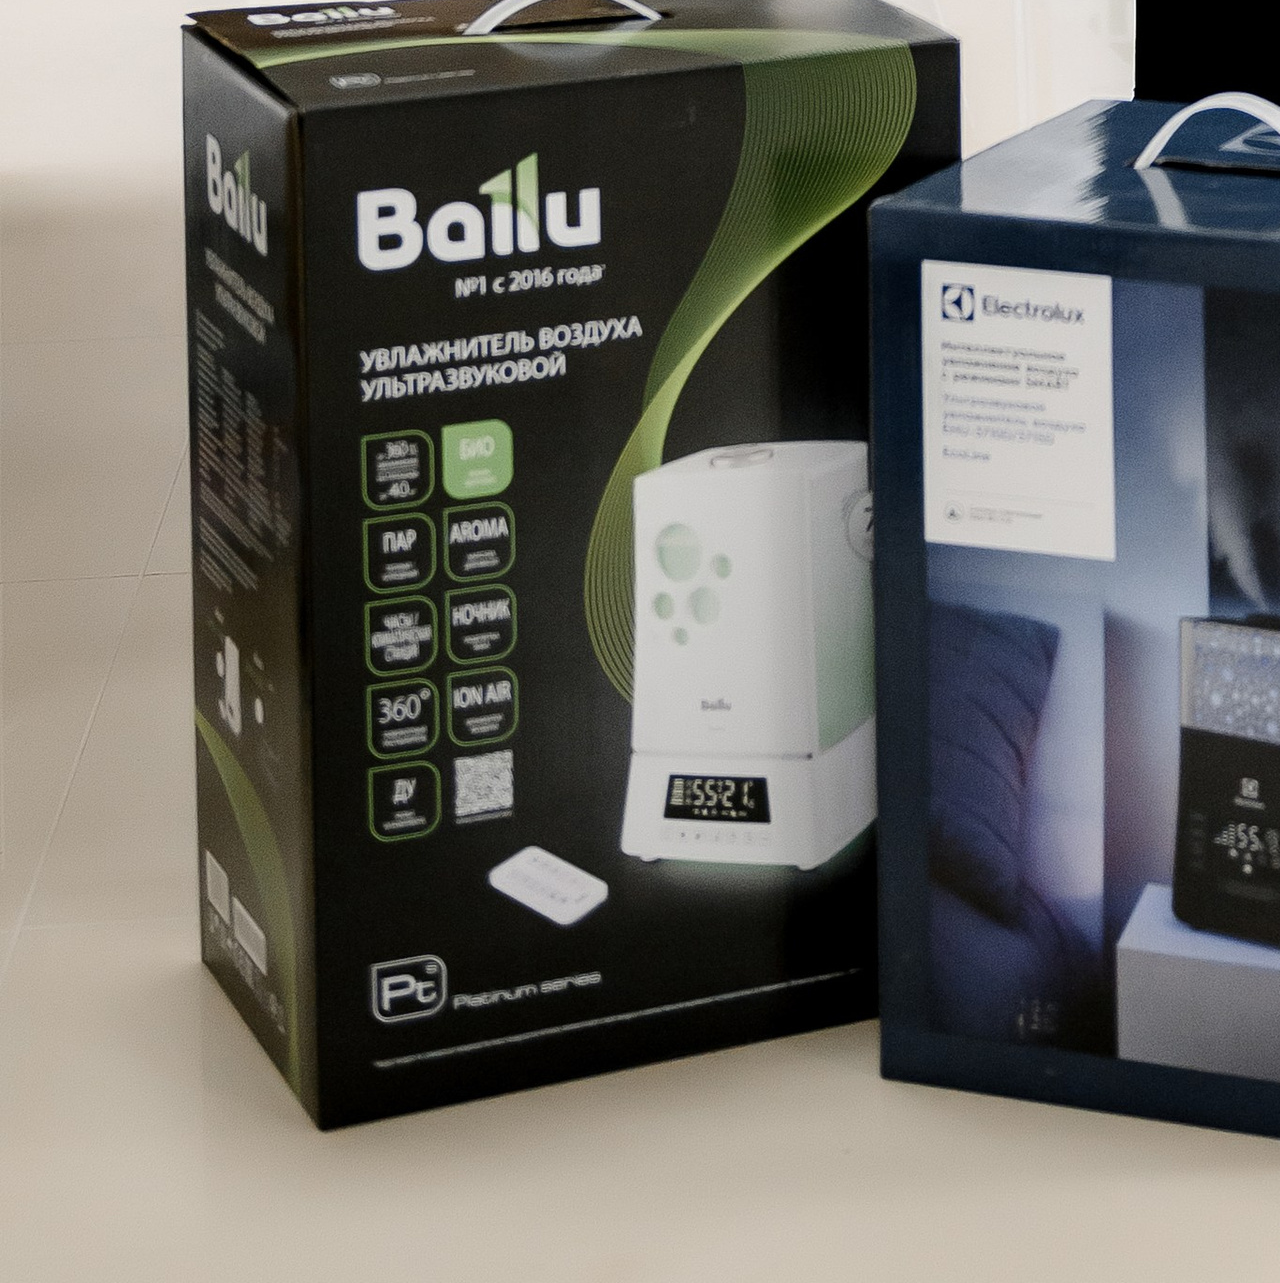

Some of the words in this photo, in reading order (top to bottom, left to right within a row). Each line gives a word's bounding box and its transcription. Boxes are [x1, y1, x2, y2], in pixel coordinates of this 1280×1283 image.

[206, 134, 268, 258] Ballu
[356, 152, 601, 271] Ballu
[455, 275, 487, 298] №1
[492, 276, 505, 294] с
[508, 266, 554, 292] 2016
[981, 294, 1085, 325] Electrolux
[360, 333, 535, 374] УВЛАЖНИТЕЛЬ
[538, 315, 643, 350] ВОЗДУХА
[360, 352, 567, 402] УЛЬТРАЗВУКОВОЙ
[382, 529, 417, 554] ПАР
[450, 516, 509, 545] AROMA
[452, 598, 511, 626] НОЧНИК
[453, 685, 484, 708] ION
[485, 680, 512, 704] AIR
[381, 974, 437, 1012] Pt
[453, 985, 537, 1010] Platinum
[539, 971, 602, 994] series
